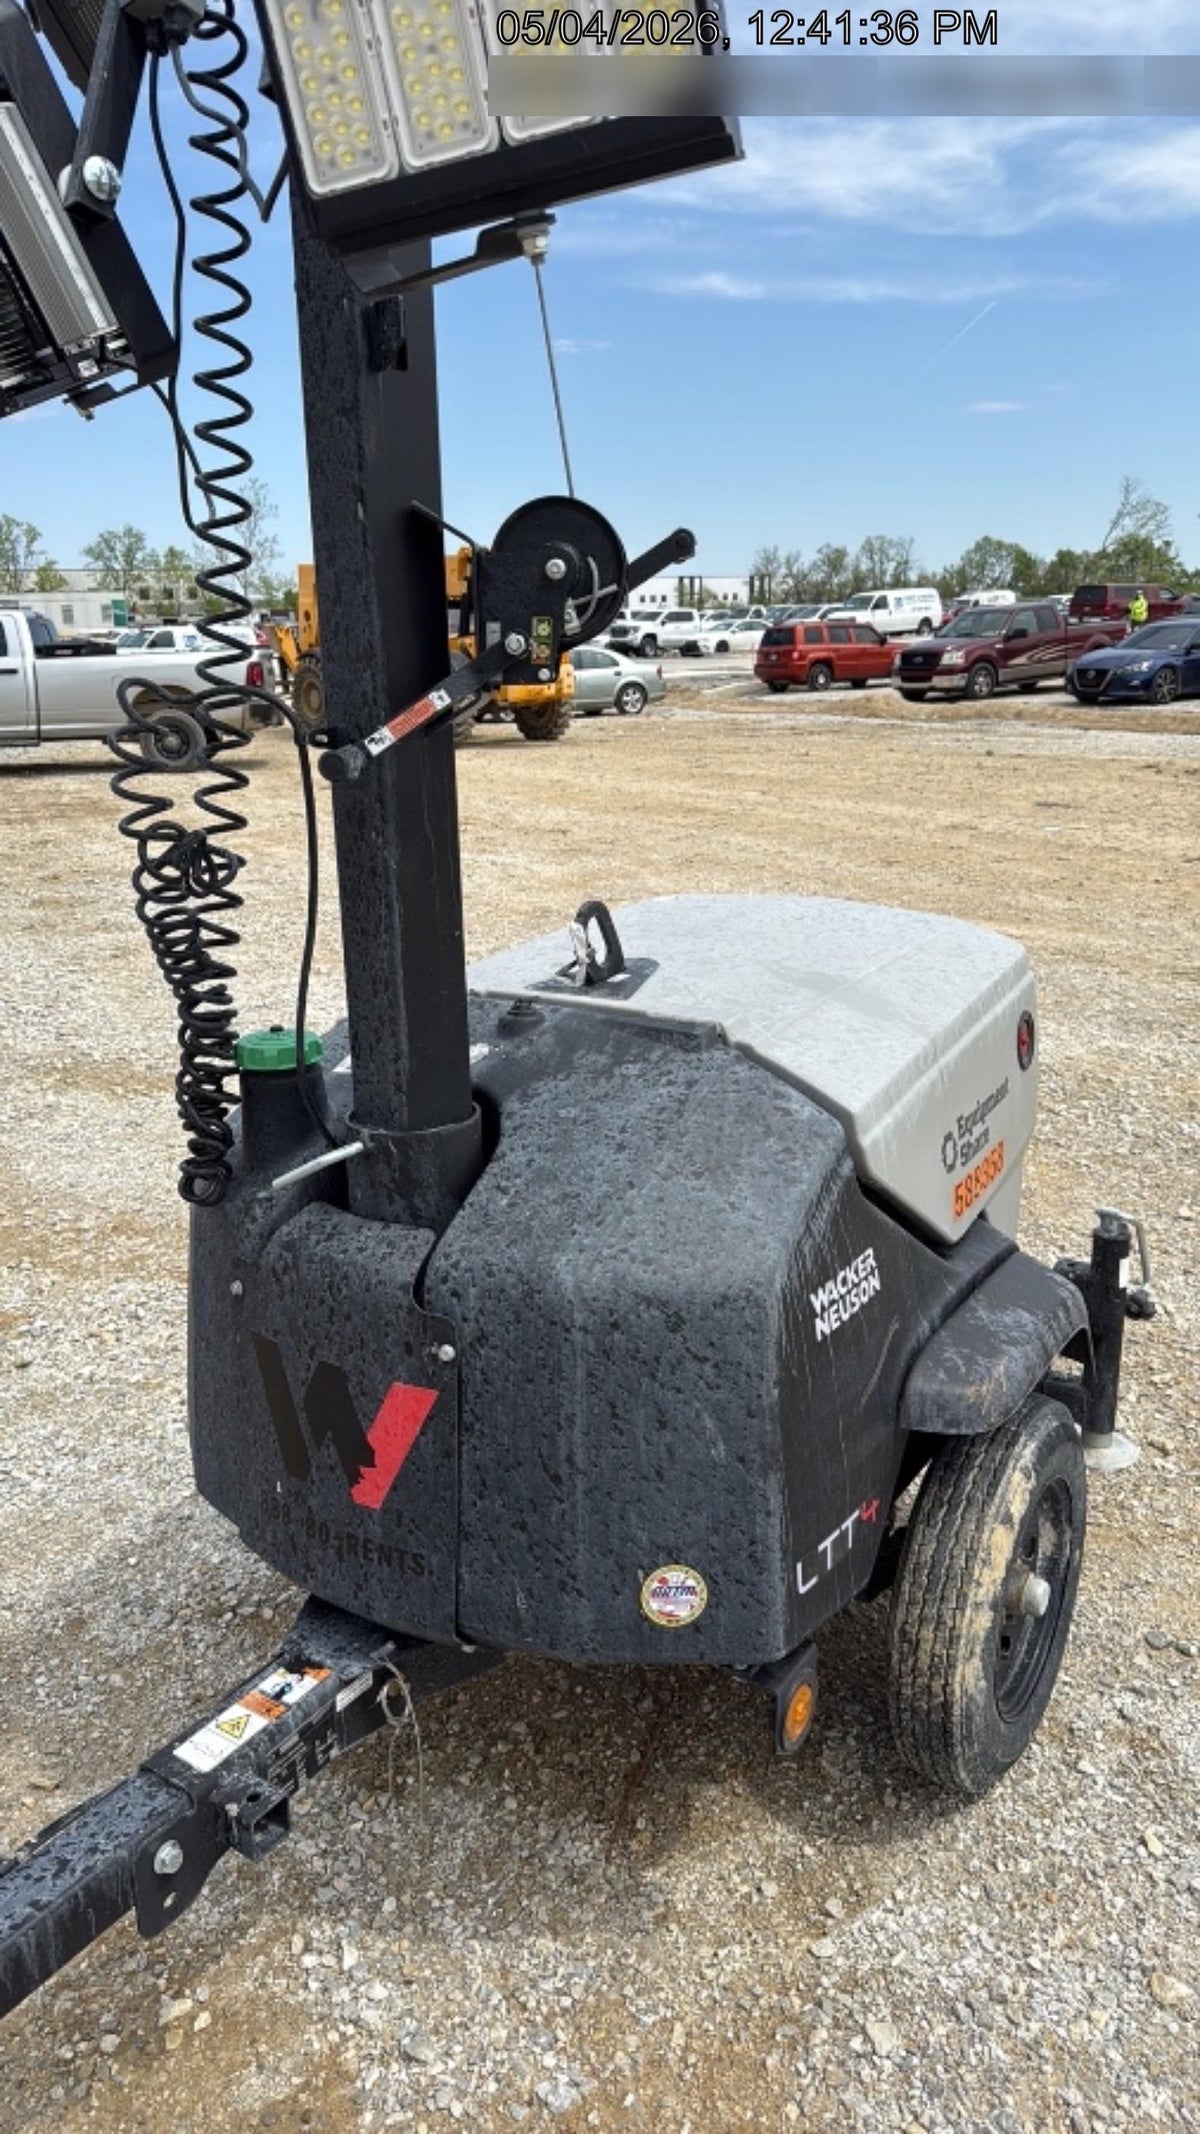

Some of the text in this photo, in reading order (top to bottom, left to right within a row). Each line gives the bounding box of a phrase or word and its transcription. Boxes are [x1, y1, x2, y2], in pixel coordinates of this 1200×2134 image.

[960, 1126, 990, 1168] Share
[809, 1246, 878, 1316] WACKER
[815, 1268, 881, 1343] NEUSON
